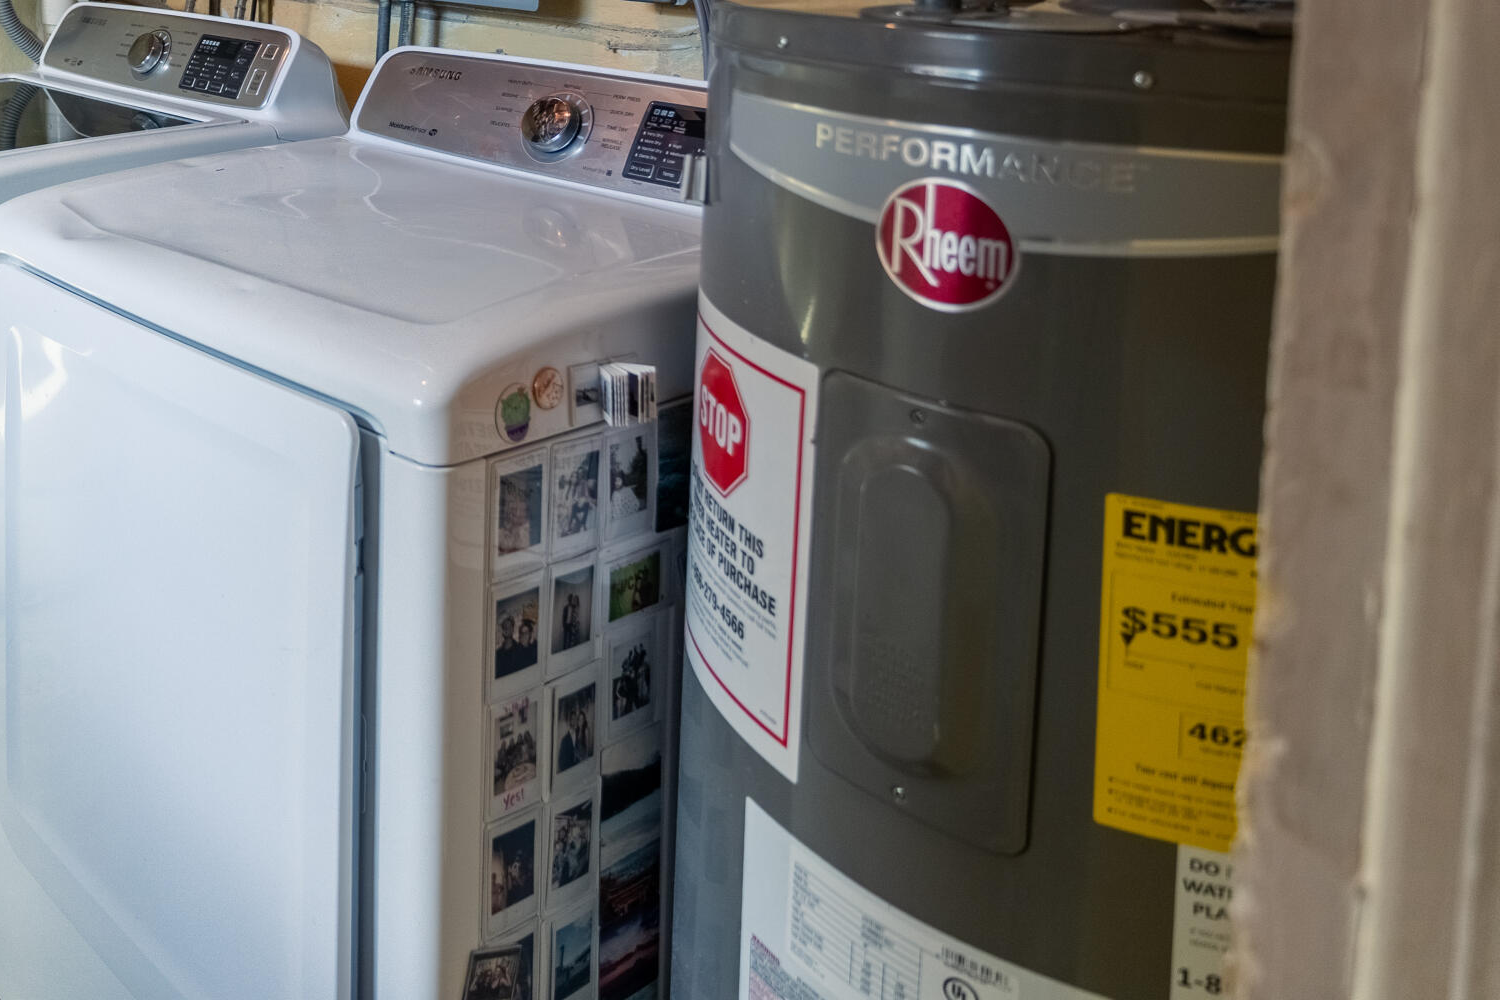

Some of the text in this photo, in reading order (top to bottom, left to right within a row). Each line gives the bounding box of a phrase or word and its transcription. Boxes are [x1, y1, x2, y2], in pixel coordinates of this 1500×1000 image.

[409, 65, 463, 81] SAMSUNG
[815, 122, 1138, 194] PERFORMANCE
[892, 181, 1009, 288] Rheem
[700, 384, 742, 457] STOP
[704, 489, 735, 536] RETURN
[738, 520, 764, 559] THIS
[706, 511, 737, 558] HEATER
[741, 546, 755, 576] TO
[706, 537, 715, 561] OF
[718, 553, 777, 617] PURCHASE
[1120, 606, 1239, 651] $555
[502, 789, 525, 811] Yes!
[1188, 857, 1221, 877] DO
